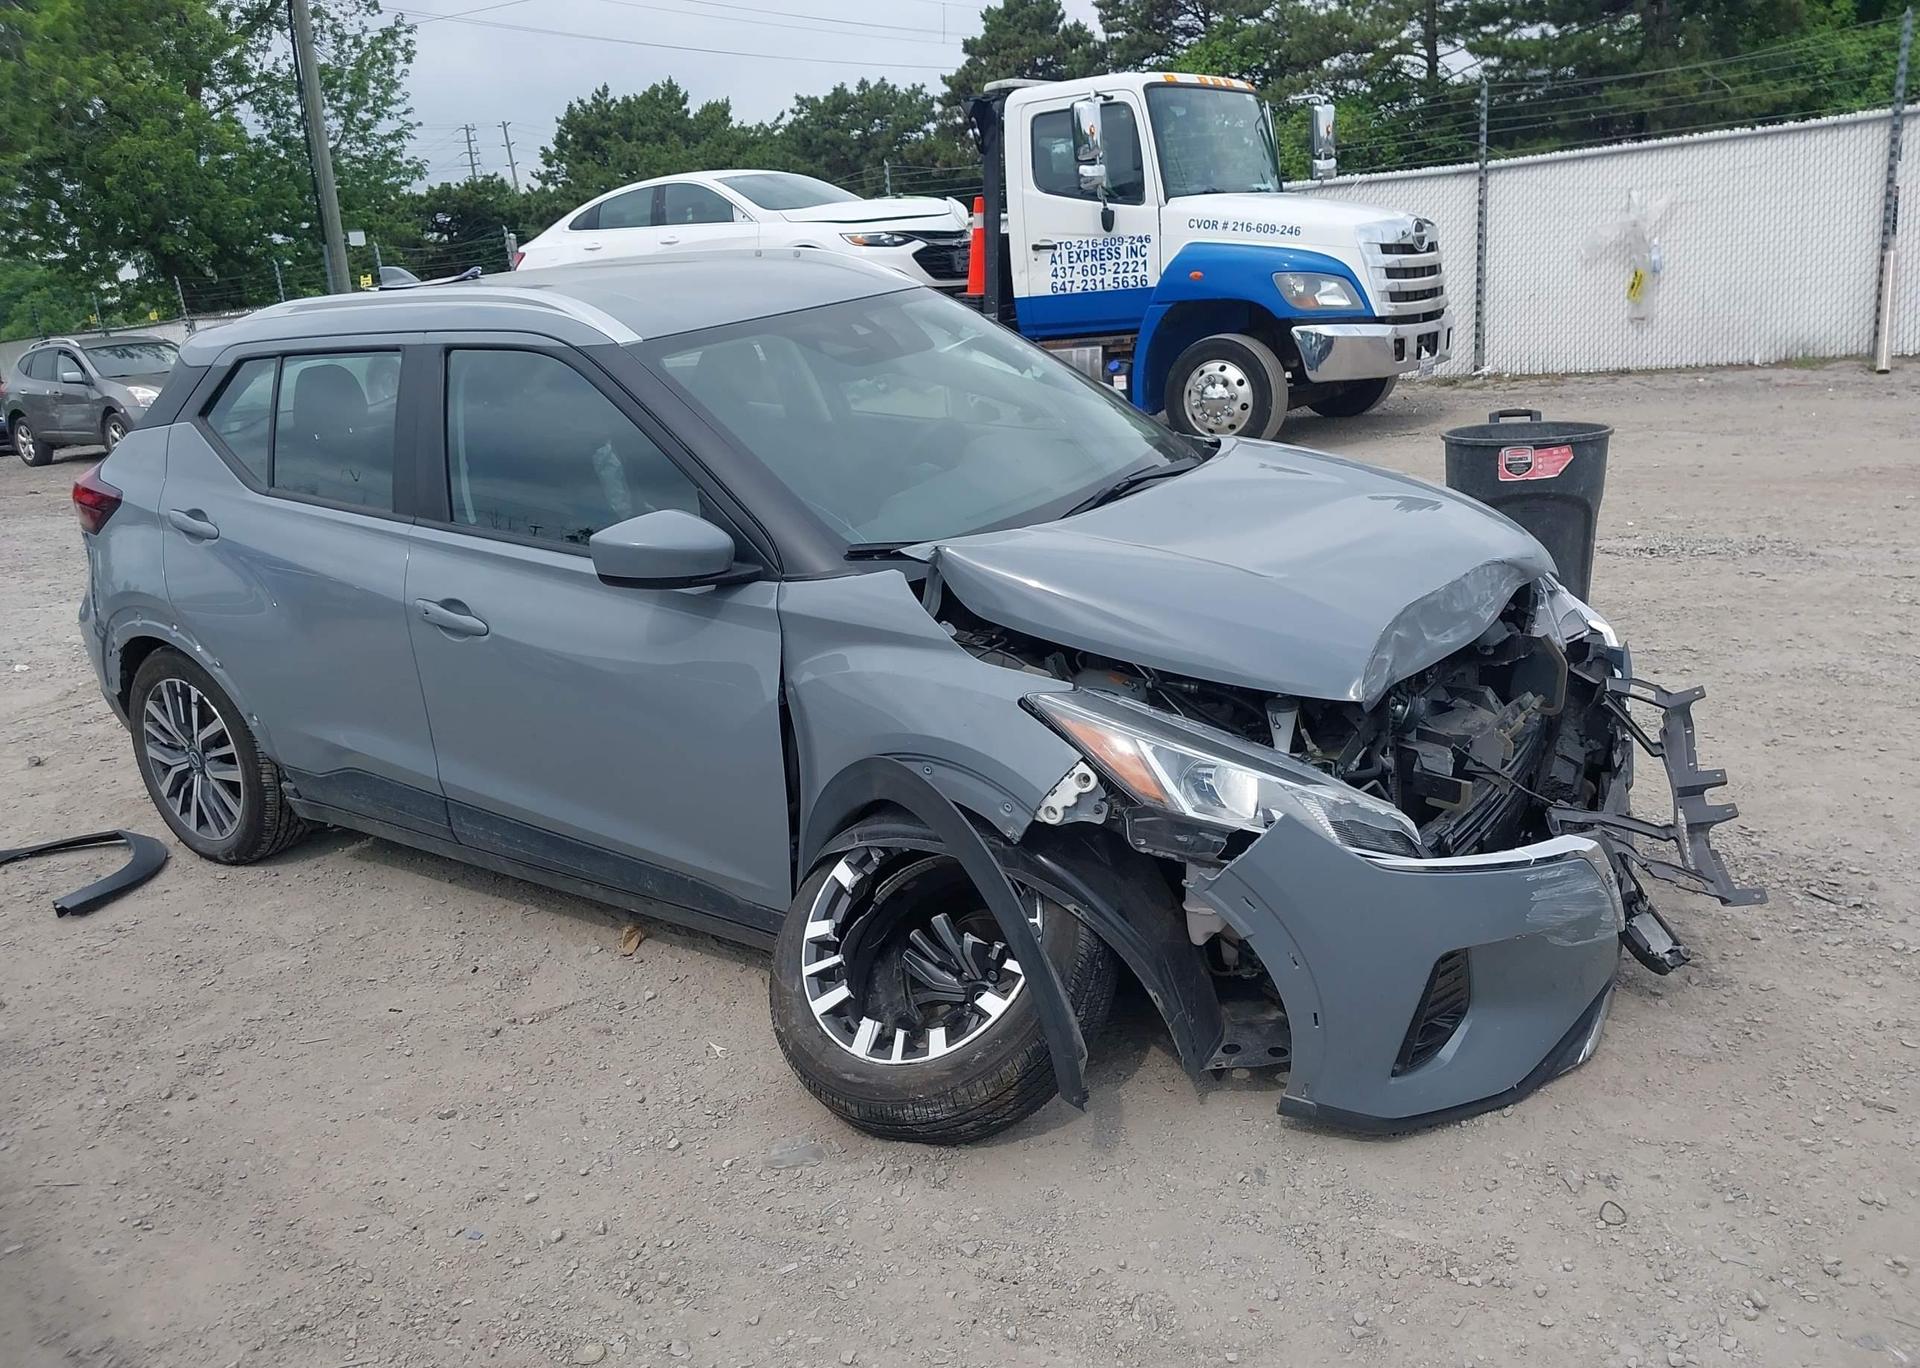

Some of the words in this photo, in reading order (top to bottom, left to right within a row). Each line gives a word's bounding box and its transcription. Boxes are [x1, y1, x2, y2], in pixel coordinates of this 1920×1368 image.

[1188, 218, 1219, 231] CVOR
[1221, 221, 1229, 231] #
[1231, 221, 1301, 237] 216-609-246
[1050, 251, 1063, 266] A1
[1067, 246, 1122, 264] EXPRESS
[1126, 244, 1148, 259] INC
[1050, 259, 1148, 279] 437-605-2221
[1050, 274, 1149, 294] 647-231-5636
